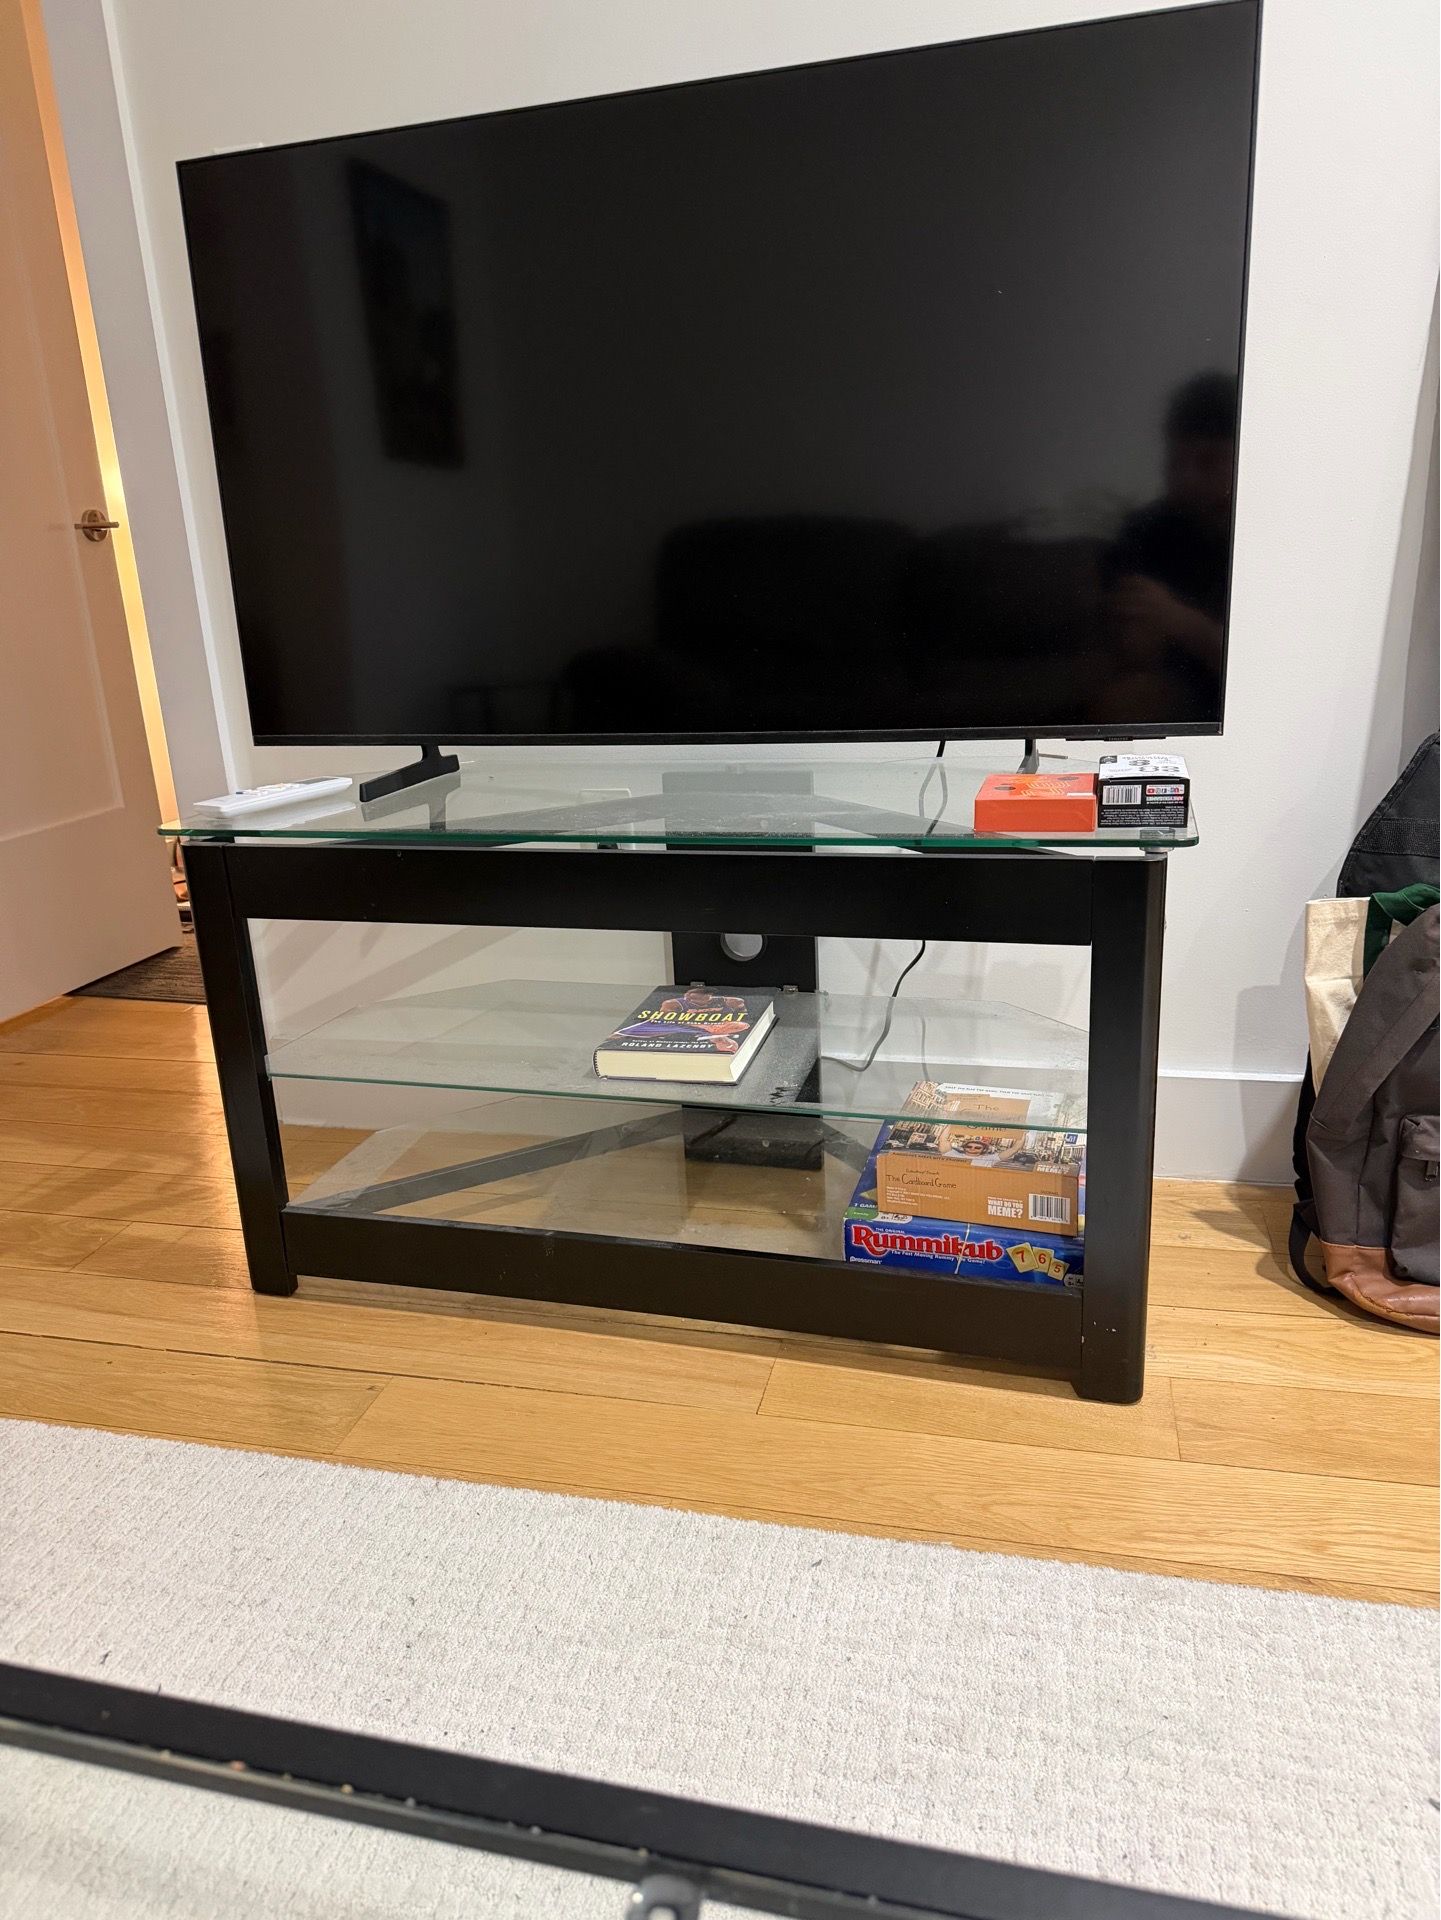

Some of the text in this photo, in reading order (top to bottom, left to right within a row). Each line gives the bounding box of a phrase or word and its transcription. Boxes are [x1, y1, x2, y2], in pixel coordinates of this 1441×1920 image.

[637, 1010, 749, 1022] SHOWBOAT
[886, 1173, 957, 1189] The Cardboard Game
[987, 1204, 1023, 1218] MEME?
[852, 1225, 1004, 1260] Rummikub
[934, 1254, 955, 1262] Rummy
[1015, 1249, 1025, 1263] 7
[1038, 1253, 1047, 1264] 6
[1053, 1264, 1062, 1273] 5
